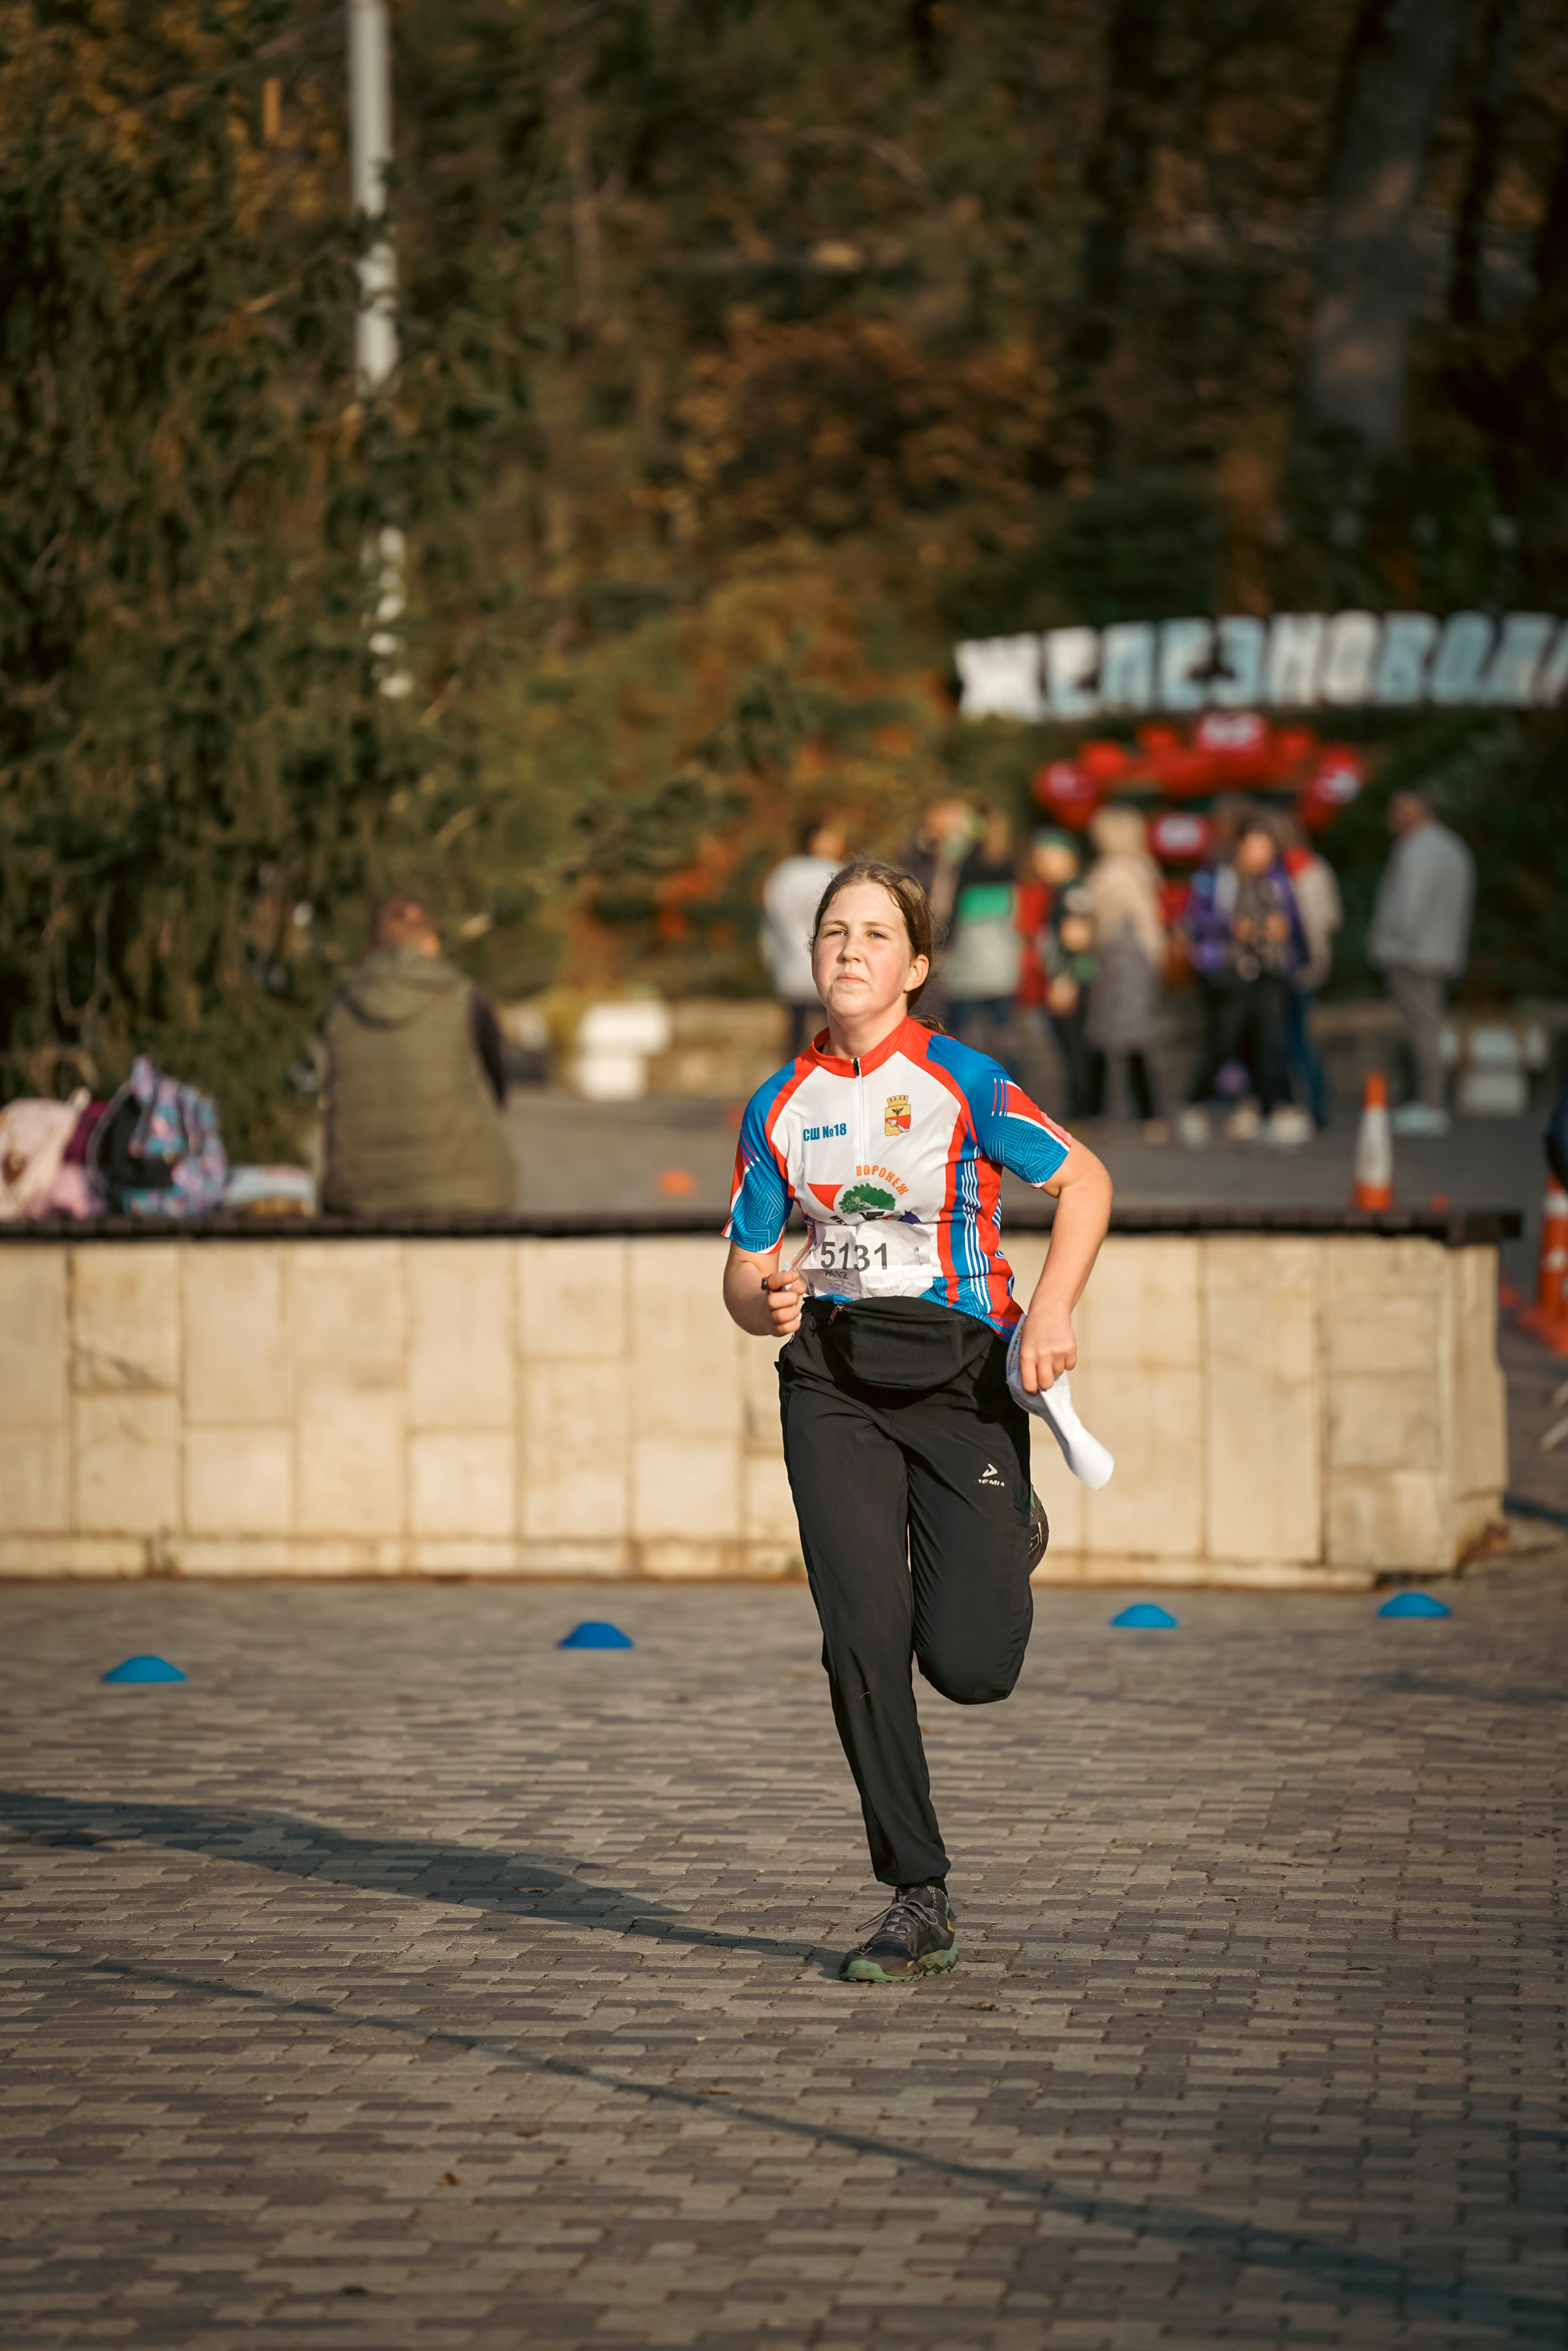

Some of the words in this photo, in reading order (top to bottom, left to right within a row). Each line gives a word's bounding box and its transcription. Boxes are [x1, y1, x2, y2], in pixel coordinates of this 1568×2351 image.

[803, 1127, 820, 1141] СШ
[823, 1123, 846, 1139] №18
[856, 1164, 910, 1196] ВОРОНЕЖ
[829, 1215, 847, 1225] МБ
[821, 1241, 888, 1272] 5131
